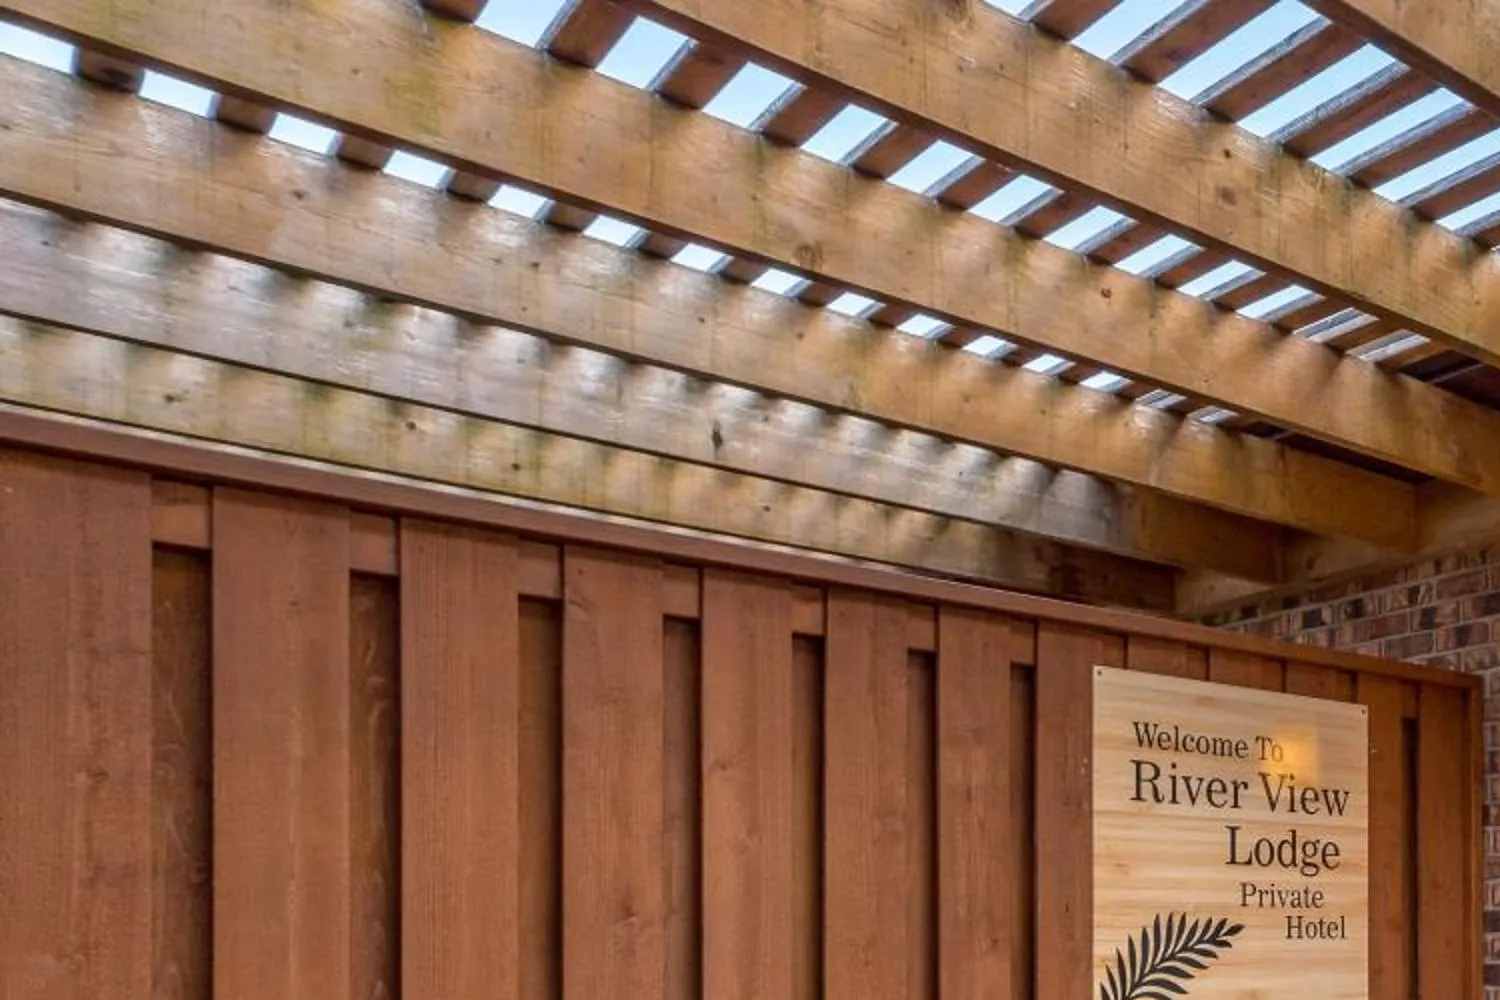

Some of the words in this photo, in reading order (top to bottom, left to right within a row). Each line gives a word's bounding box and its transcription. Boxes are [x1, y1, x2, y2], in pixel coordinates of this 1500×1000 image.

[1132, 720, 1249, 759] Welcome
[1255, 735, 1284, 762] To
[1129, 759, 1249, 809] River
[1257, 771, 1350, 817] View
[1224, 825, 1341, 877] Lodge
[1240, 881, 1324, 909] Private
[1285, 915, 1347, 940] Hotel
